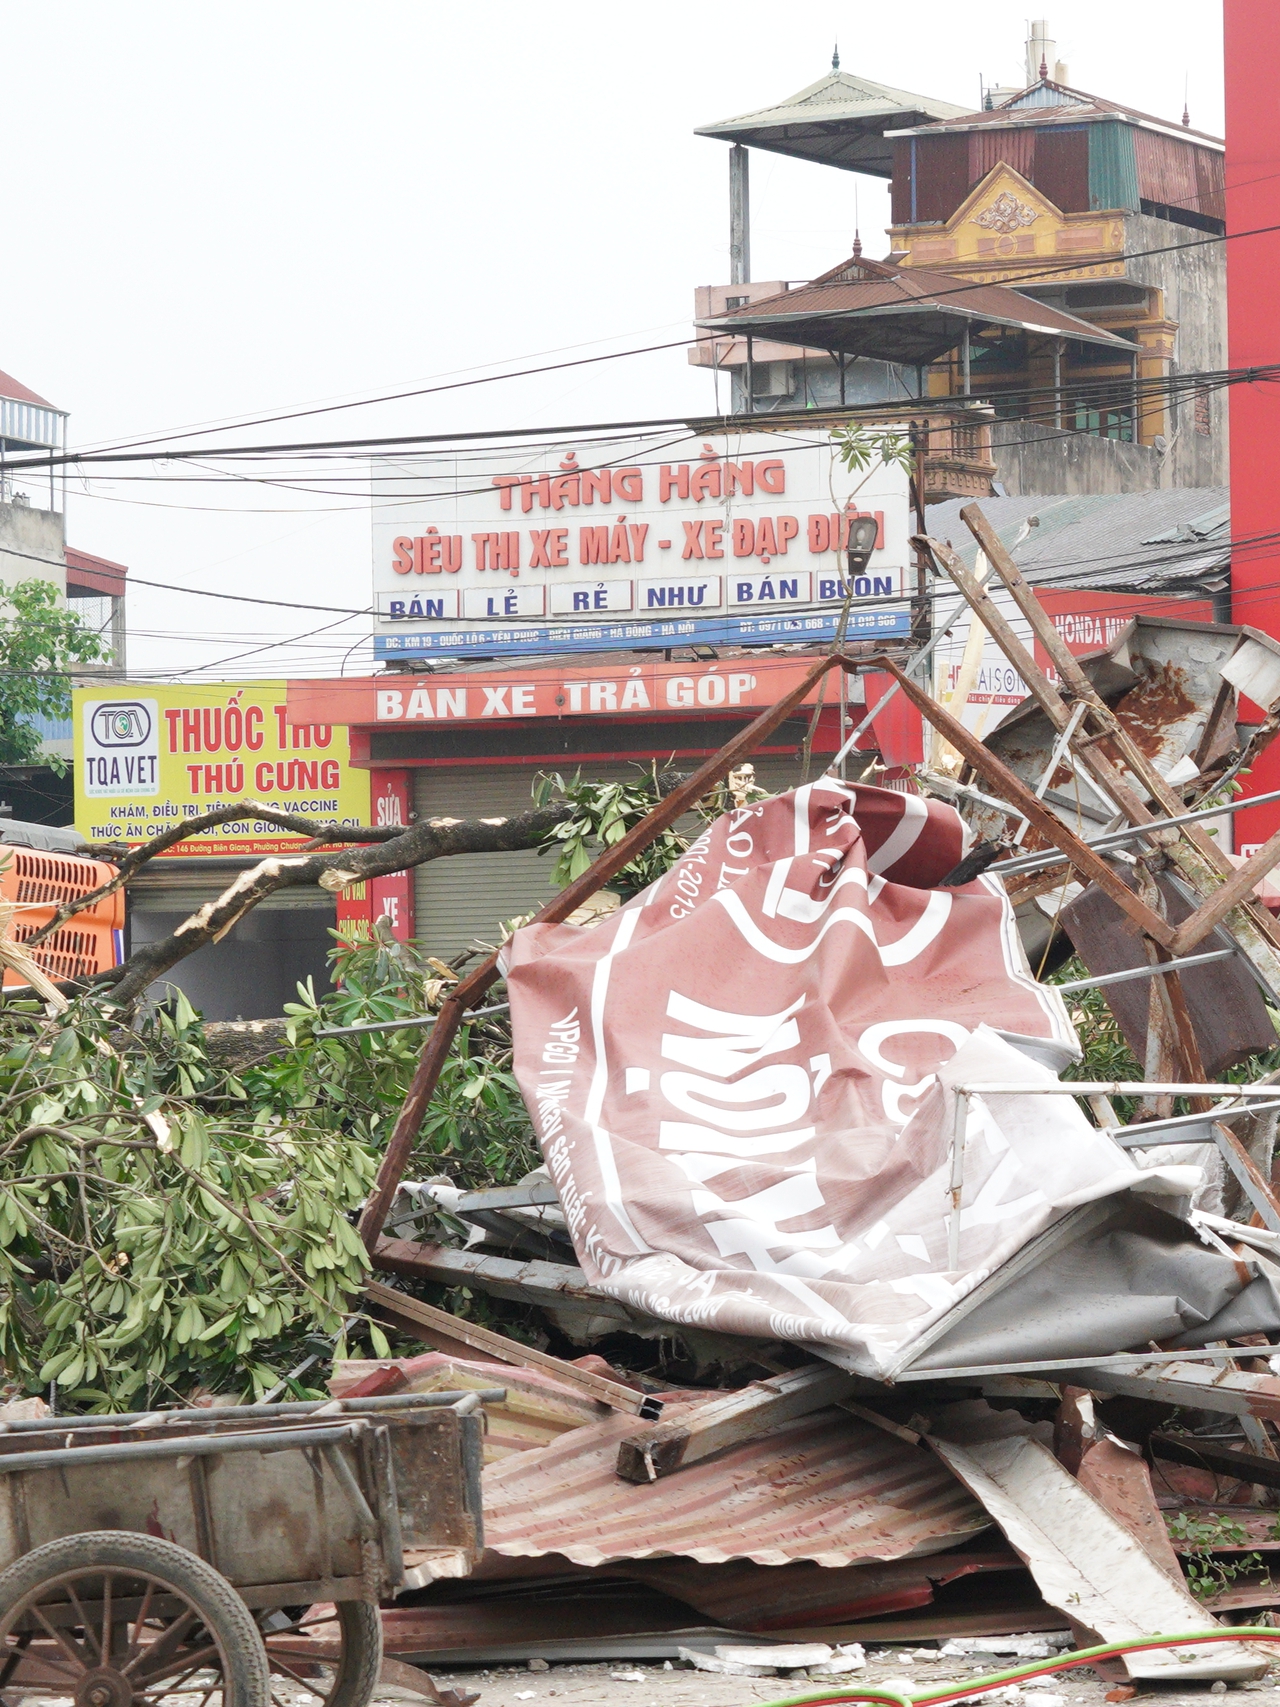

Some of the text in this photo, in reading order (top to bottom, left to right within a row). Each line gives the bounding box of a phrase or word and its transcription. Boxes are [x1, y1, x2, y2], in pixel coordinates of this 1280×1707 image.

[391, 526, 463, 575] SIÊU
[471, 530, 521, 578] THỊ
[529, 528, 570, 569] XE
[579, 515, 650, 565] MÁY
[681, 520, 725, 560] XE
[732, 515, 799, 563] ĐẠP
[486, 588, 519, 616] LẺ
[572, 582, 609, 611] RẺ
[647, 583, 708, 608] NHƯ
[736, 575, 799, 602] BÁN
[389, 590, 445, 620] BÁN
[805, 617, 823, 630] 668
[1055, 615, 1103, 645] HONDA
[377, 667, 757, 722] BÁN XE TRẢ GÓP
[165, 690, 264, 753] THUỐC
[187, 757, 340, 794] THÚ CƯNG
[110, 803, 149, 819] KHÁM,
[153, 800, 178, 817] ĐIỀU
[283, 800, 338, 812] VACCINE
[91, 823, 122, 838] THỨC
[126, 823, 142, 836] ĂN
[177, 845, 188, 853] 146
[542, 1006, 581, 1063] VPGD
